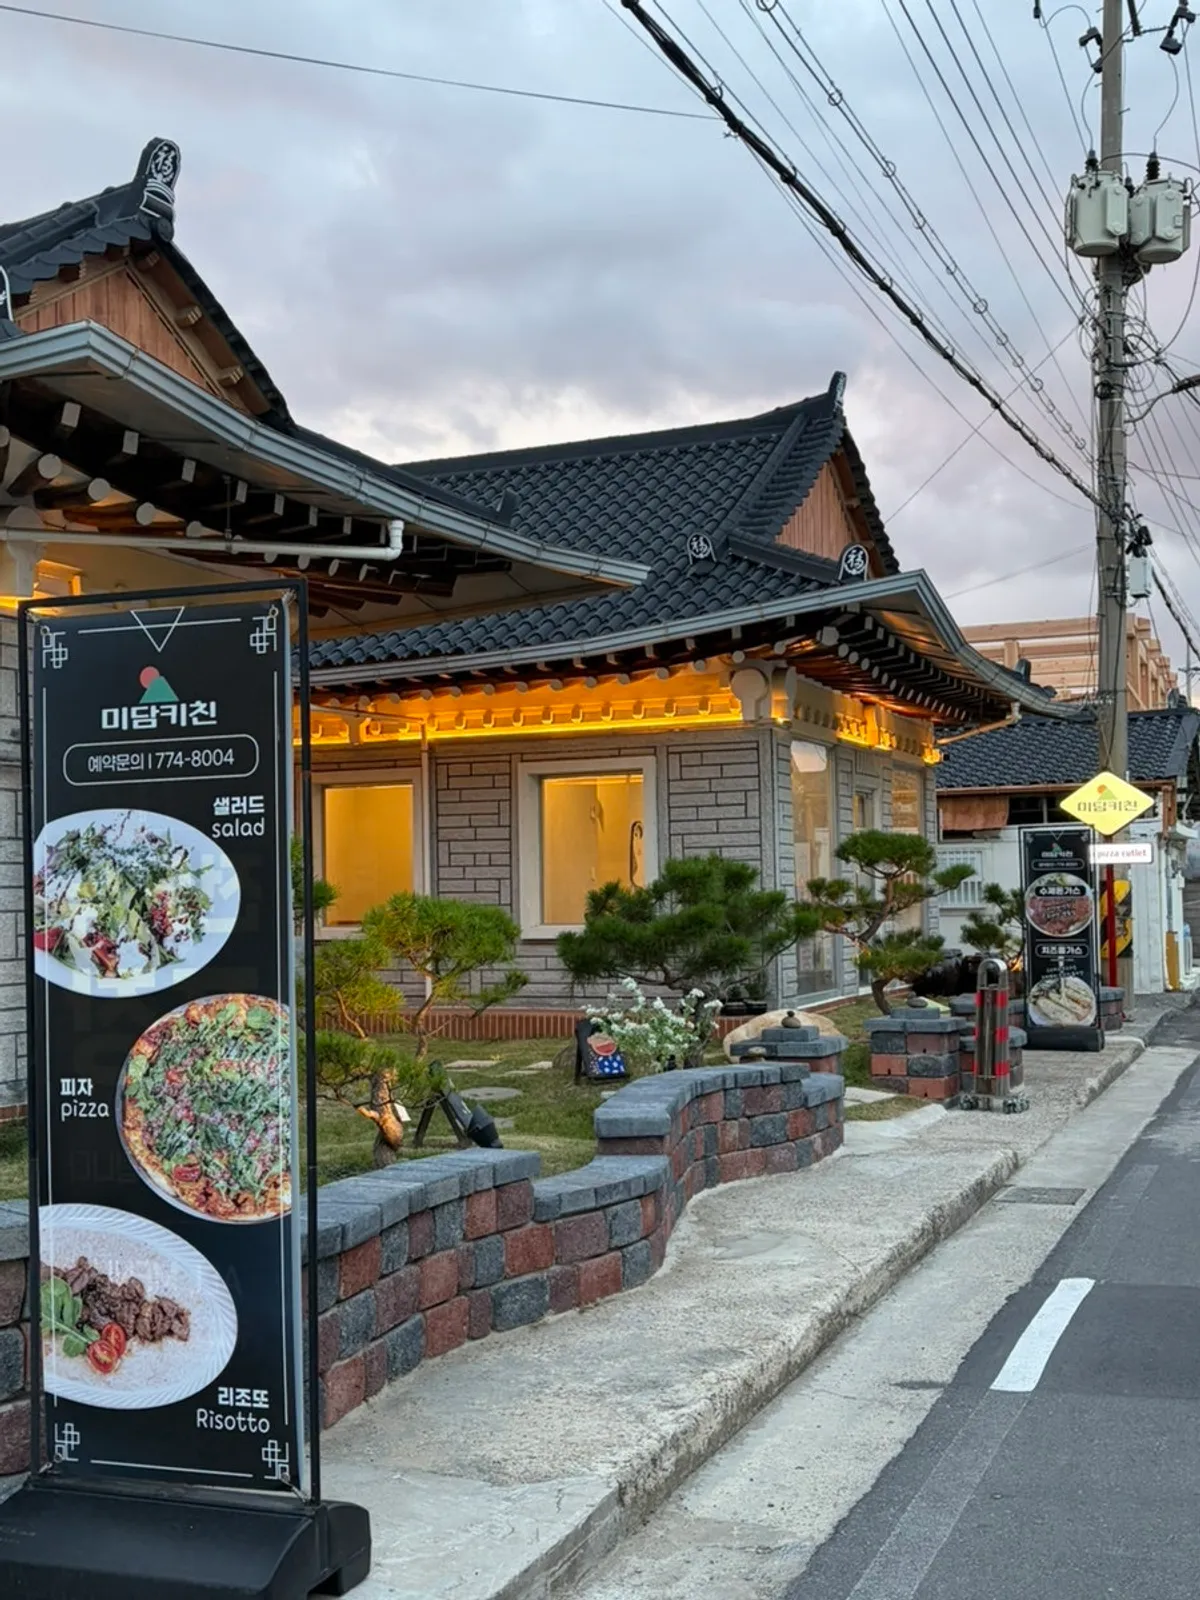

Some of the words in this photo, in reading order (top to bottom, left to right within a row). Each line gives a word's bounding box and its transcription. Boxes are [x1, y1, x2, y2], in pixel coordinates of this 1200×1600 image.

[101, 700, 218, 731] 미담키친
[88, 752, 145, 773] 예약문의
[156, 748, 235, 769] 774-8004
[213, 795, 265, 816] 샐러드
[1077, 801, 1138, 812] 미담키친
[211, 817, 265, 838] salad
[60, 1077, 94, 1097] 피자
[60, 1098, 110, 1122] pizza
[217, 1386, 270, 1408] 리조또
[196, 1408, 270, 1433] Risotto
